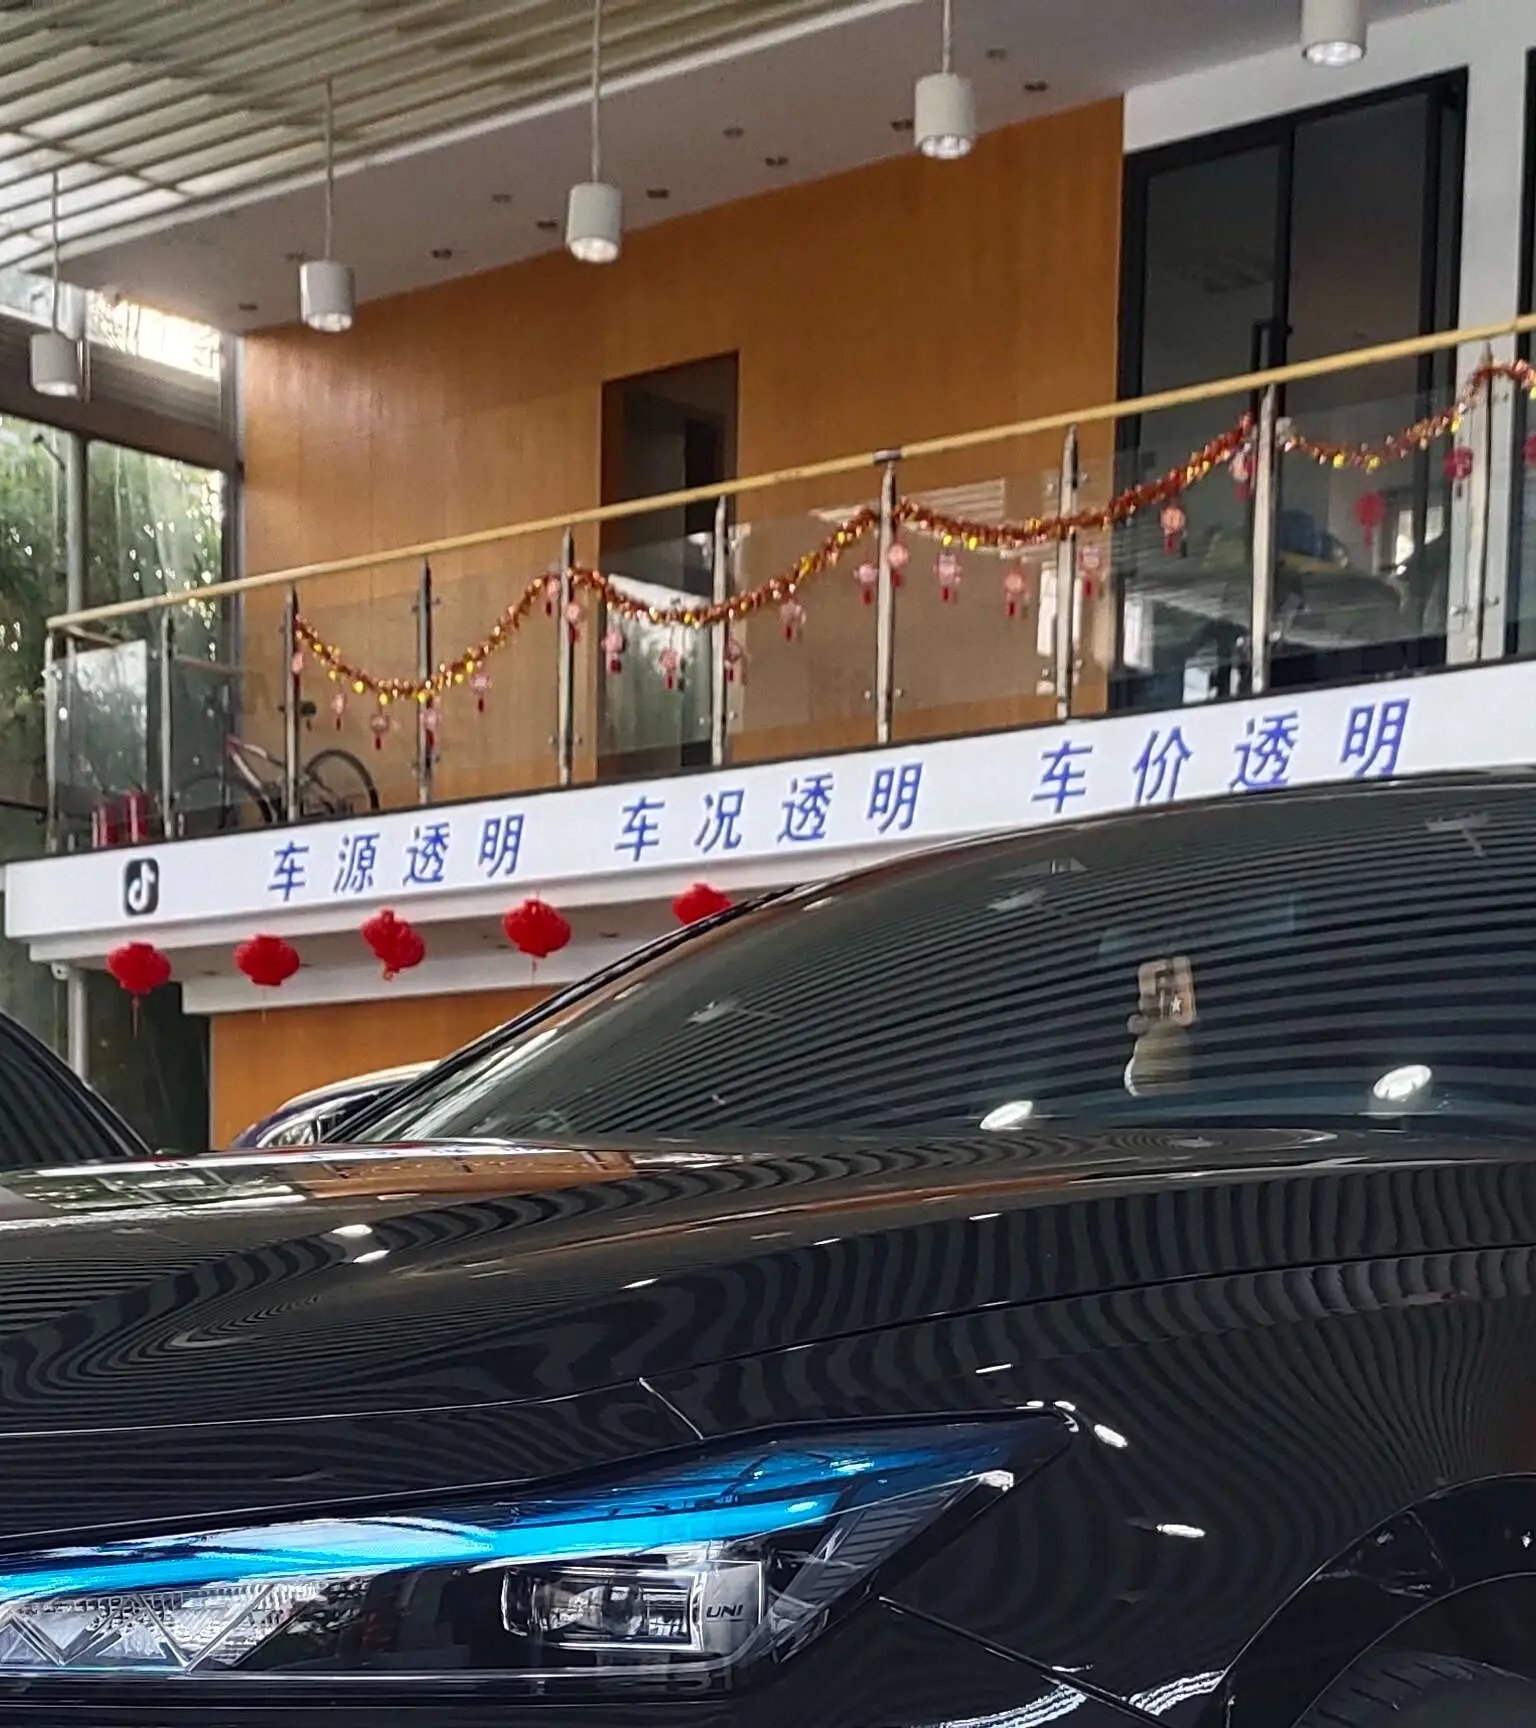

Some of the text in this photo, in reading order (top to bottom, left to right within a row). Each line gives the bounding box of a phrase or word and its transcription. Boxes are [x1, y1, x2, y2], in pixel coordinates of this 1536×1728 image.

[268, 698, 1412, 902] 车源透明 车况透明 车价透明
[706, 1604, 744, 1618] UNI
